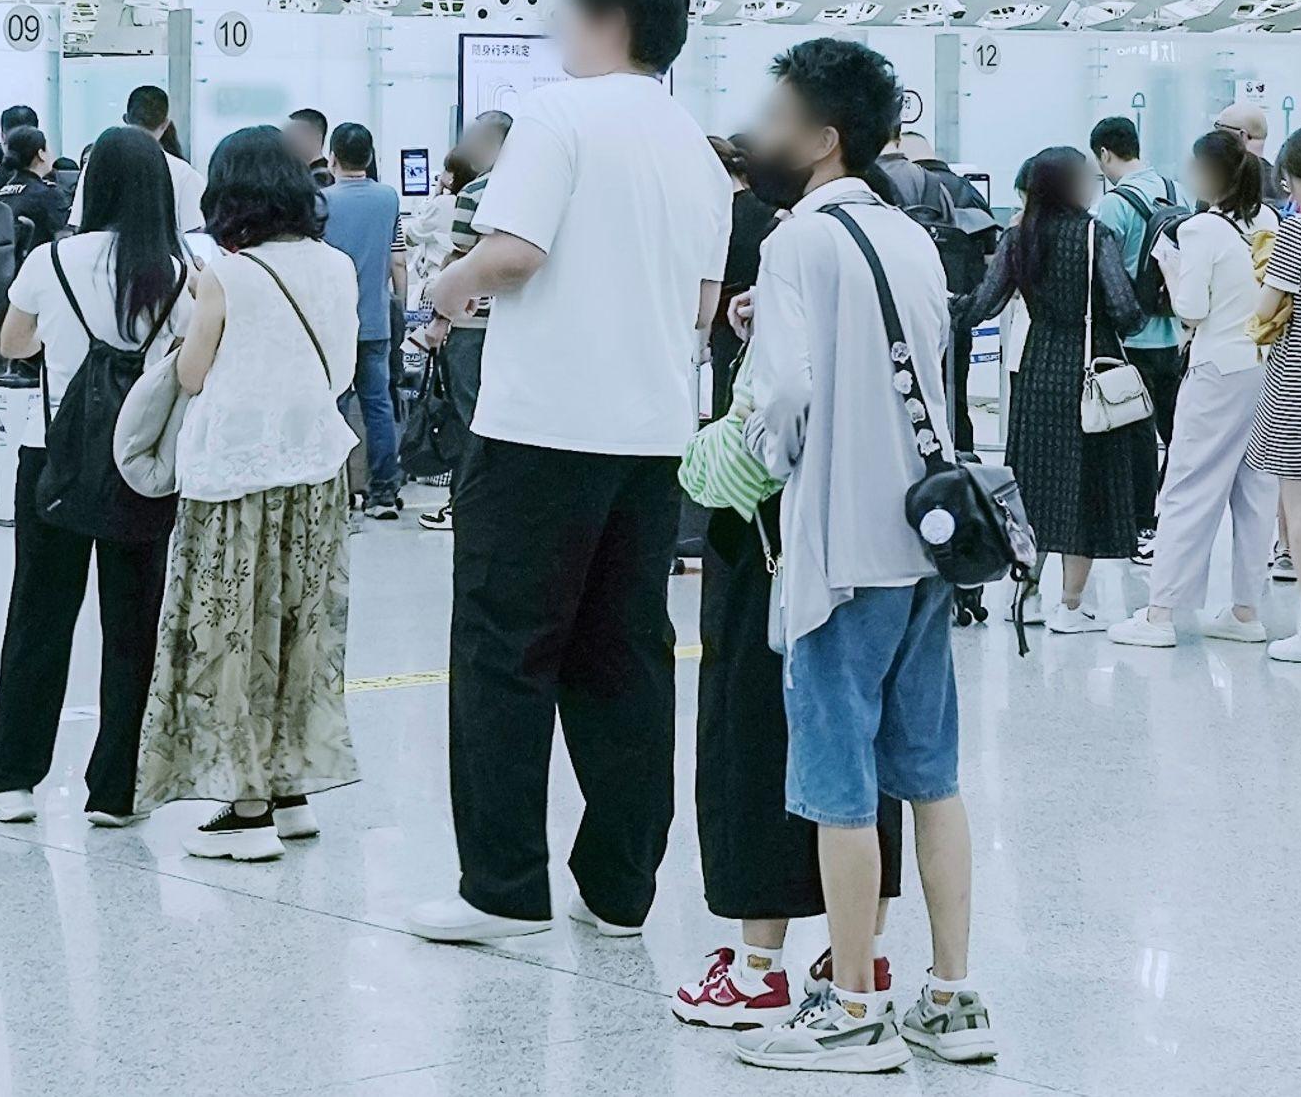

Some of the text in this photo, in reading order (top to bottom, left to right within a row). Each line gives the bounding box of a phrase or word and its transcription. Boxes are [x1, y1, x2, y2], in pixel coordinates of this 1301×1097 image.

[6, 14, 41, 43] 09
[219, 19, 248, 48] 10
[975, 43, 998, 68] 12
